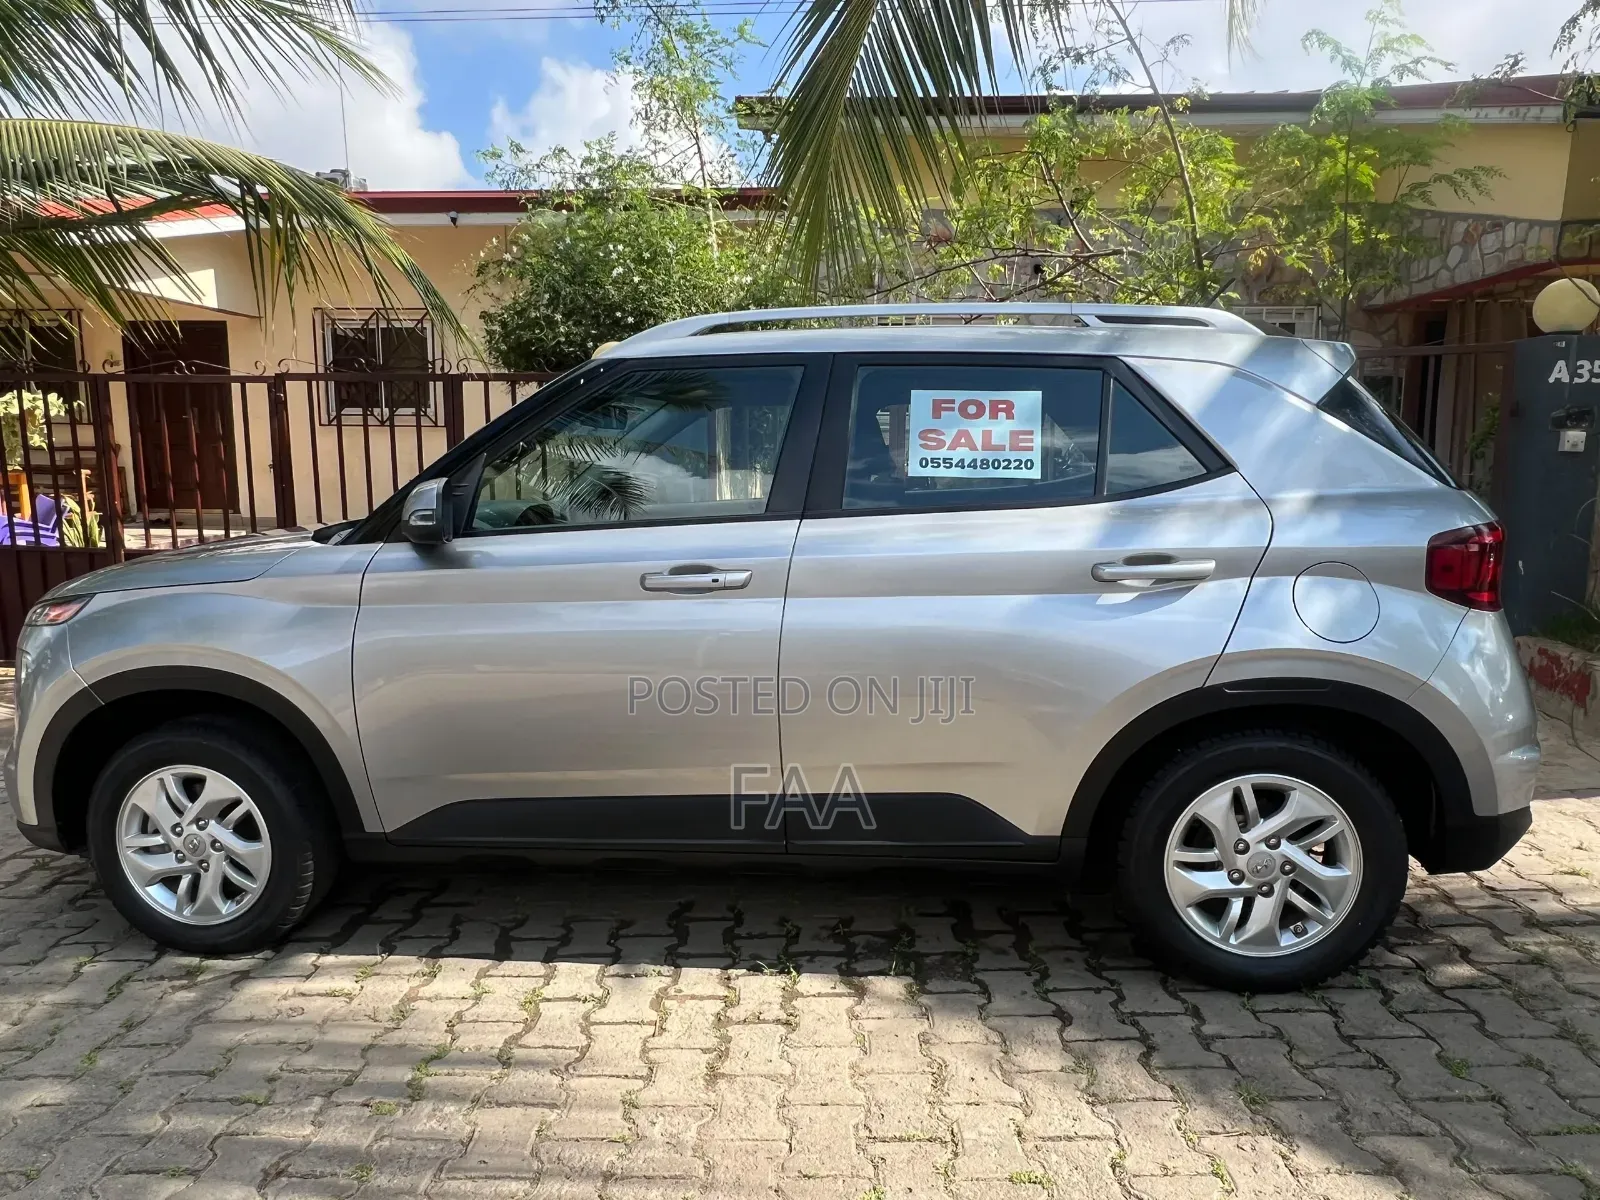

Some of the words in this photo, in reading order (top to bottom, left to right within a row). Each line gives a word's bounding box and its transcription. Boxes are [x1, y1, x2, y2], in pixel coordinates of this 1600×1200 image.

[931, 398, 1015, 420] FOR
[917, 428, 1035, 452] SALE
[918, 456, 1035, 471] 0554480220
